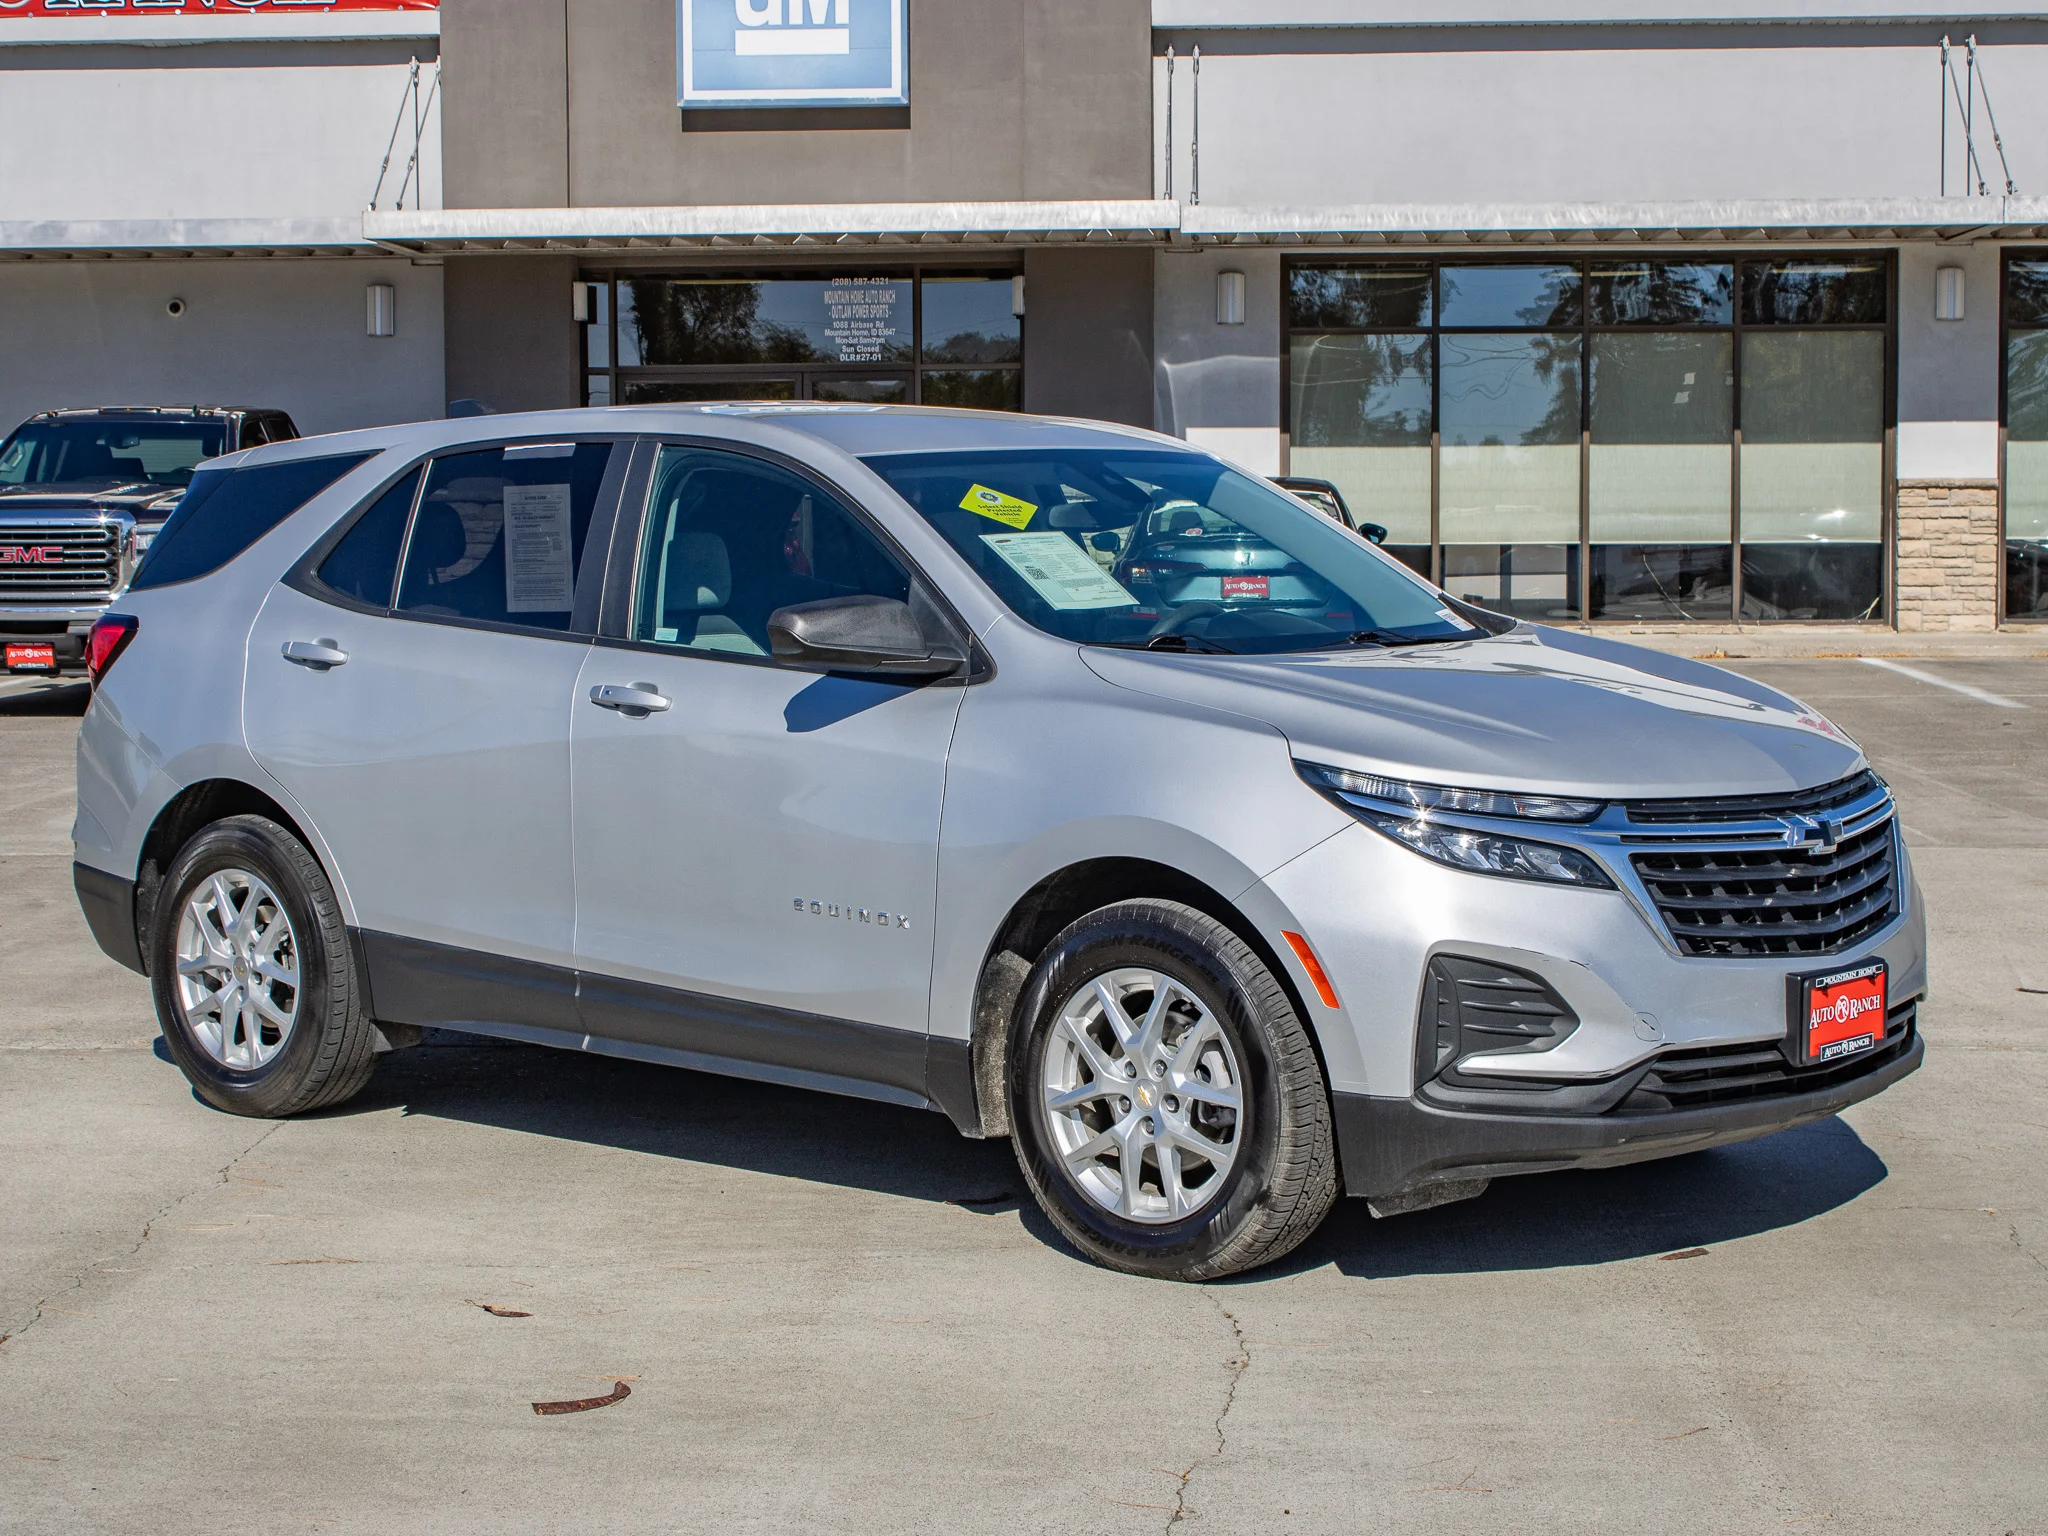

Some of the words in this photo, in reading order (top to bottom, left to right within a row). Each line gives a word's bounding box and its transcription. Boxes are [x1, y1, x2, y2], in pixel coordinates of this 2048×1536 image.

[853, 277, 889, 286] 587-4321
[823, 291, 850, 304] MOUNTAIN
[850, 290, 864, 304] HOME
[865, 290, 878, 303] AUTO
[878, 290, 896, 303] RANCH
[852, 305, 869, 318] POWER
[870, 305, 889, 318] SPORTS
[0, 546, 63, 563] GMC
[9, 650, 25, 658] AUTO
[793, 897, 910, 929] EQUINOX
[1823, 970, 1857, 985] MOUNTAIN
[1858, 966, 1877, 977] HOME
[1809, 1006, 1835, 1030] AUTO
[1849, 994, 1881, 1020] RANCH
[1824, 1045, 1841, 1059] AUTO
[1848, 1036, 1870, 1052] RANCH
